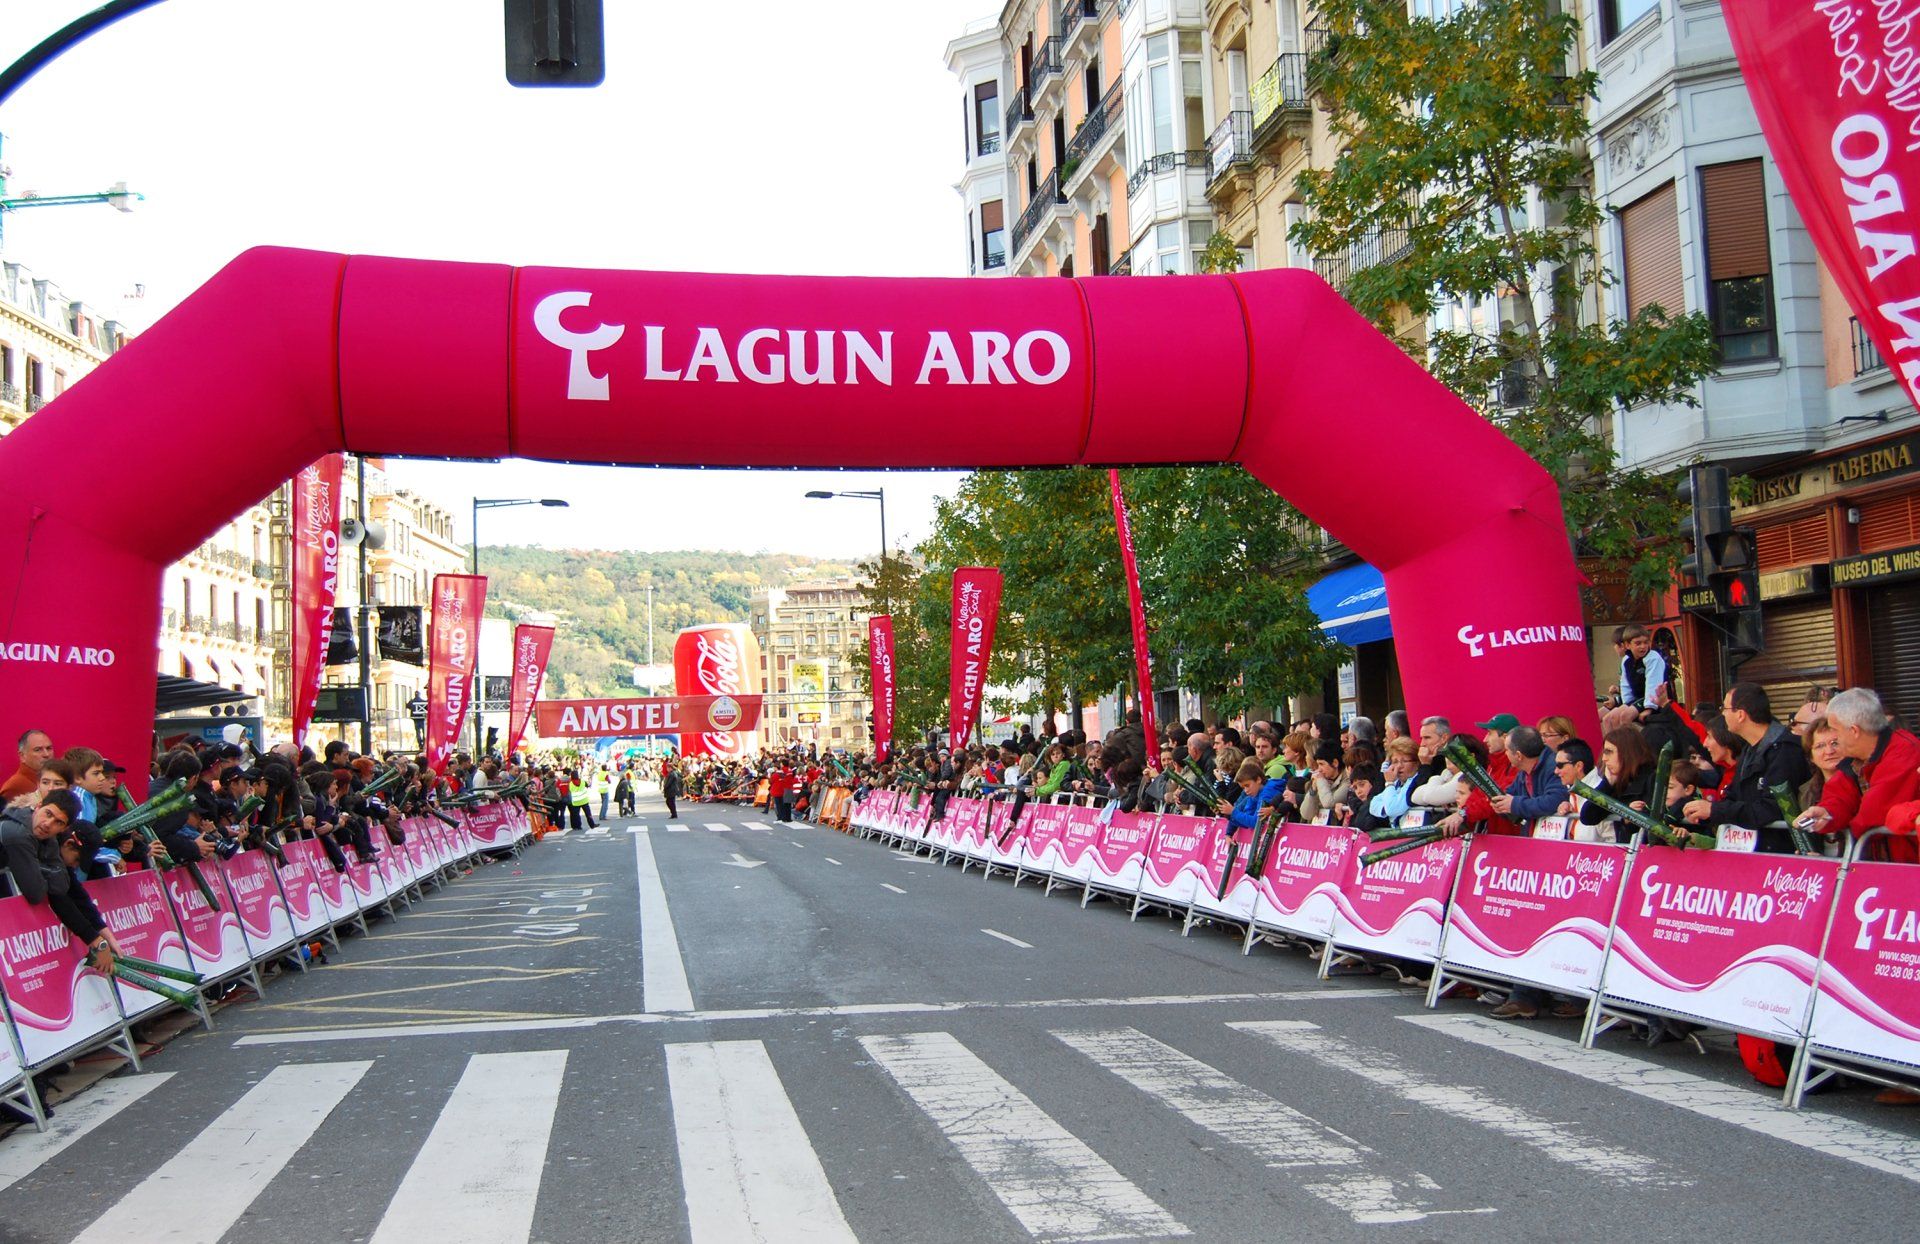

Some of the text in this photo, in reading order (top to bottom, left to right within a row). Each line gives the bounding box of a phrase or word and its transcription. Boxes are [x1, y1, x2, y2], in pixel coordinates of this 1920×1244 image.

[643, 326, 1071, 387] LAGUN ARO
[1751, 443, 1913, 505] HISKY TABERNA
[322, 529, 340, 598] ARO
[1834, 561, 1870, 583] MUSEO
[1872, 556, 1892, 576] DEL
[1682, 592, 1700, 608] SALA
[1700, 590, 1709, 605] DE
[1488, 625, 1583, 648] LAGUN ARO
[66, 646, 115, 667] ARO
[964, 617, 983, 721] AGUN ARO
[447, 627, 467, 736] AGUN ARO
[558, 704, 679, 732] AMSTEL
[1283, 847, 1330, 870] LAGUN ARO
[1366, 859, 1427, 884] LAGUN ARO
[1488, 866, 1576, 900] LAGUN ARO
[1660, 883, 1774, 924] LAGUN ARO
[1776, 893, 1808, 921] Social
[107, 906, 138, 933] LAGUN
[1656, 917, 1735, 937] www.seguroslagunaro.com
[1883, 908, 1920, 943] LA
[5, 922, 69, 963] LAGUN ARO
[1653, 928, 1664, 939] 902
[1664, 930, 1673, 941] 38
[1680, 932, 1690, 943] 38
[1874, 963, 1890, 977] 902
[1890, 966, 1902, 979] 38
[1902, 967, 1914, 980] 08
[1769, 1003, 1791, 1015] Laboral
